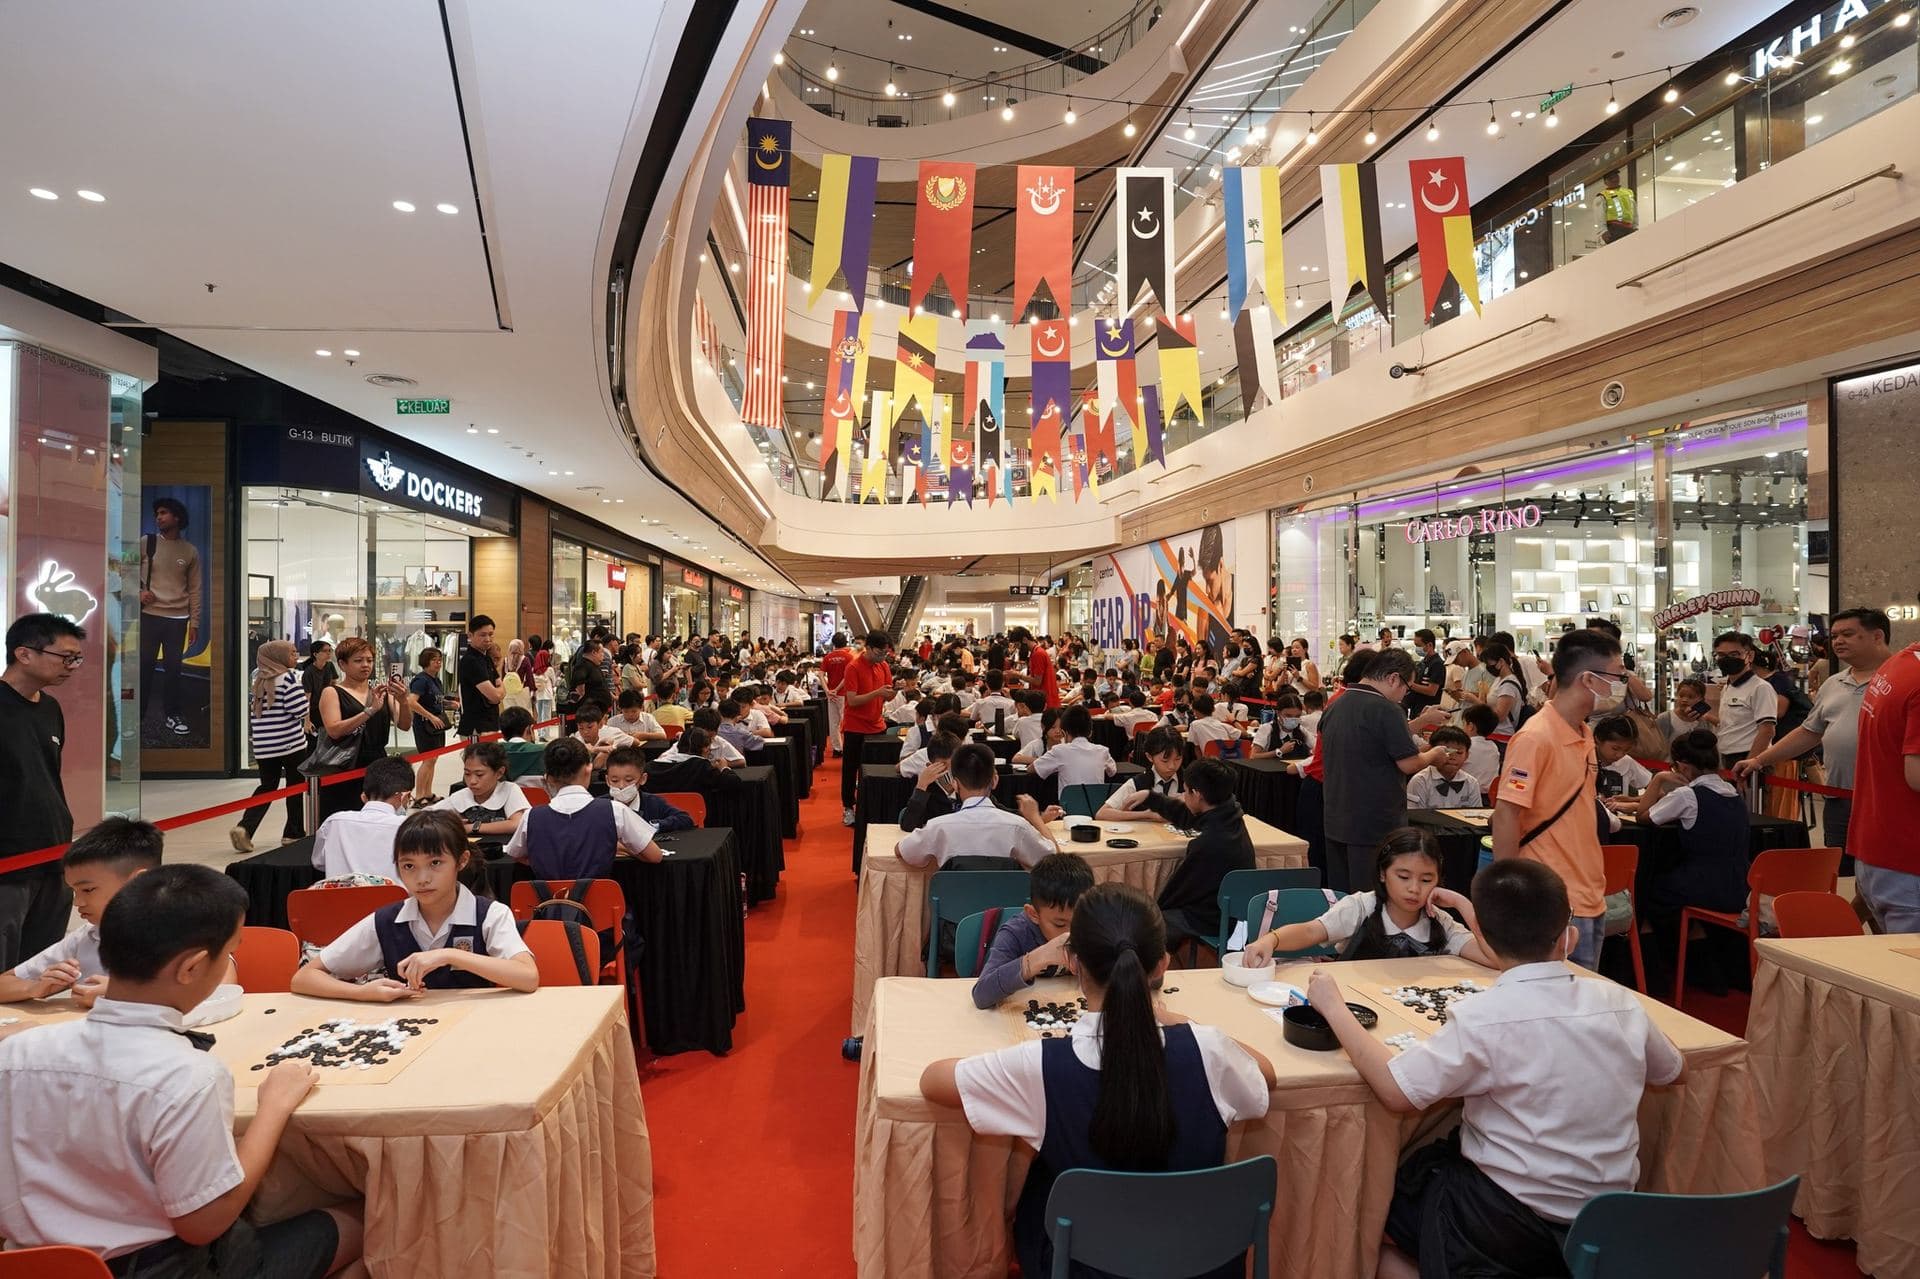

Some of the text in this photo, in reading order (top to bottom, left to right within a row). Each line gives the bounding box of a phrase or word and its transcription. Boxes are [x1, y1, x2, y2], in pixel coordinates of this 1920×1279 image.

[1755, 0, 1891, 78] KHA
[1872, 373, 1920, 395] KEDA
[407, 401, 448, 413] KELUAR
[288, 428, 353, 446] G-13 BUTIK
[407, 472, 481, 517] DOCKERS
[1405, 504, 1541, 544] CARLO RINO
[1092, 592, 1151, 651] GEAR UP
[1654, 596, 1707, 629] HARLEY
